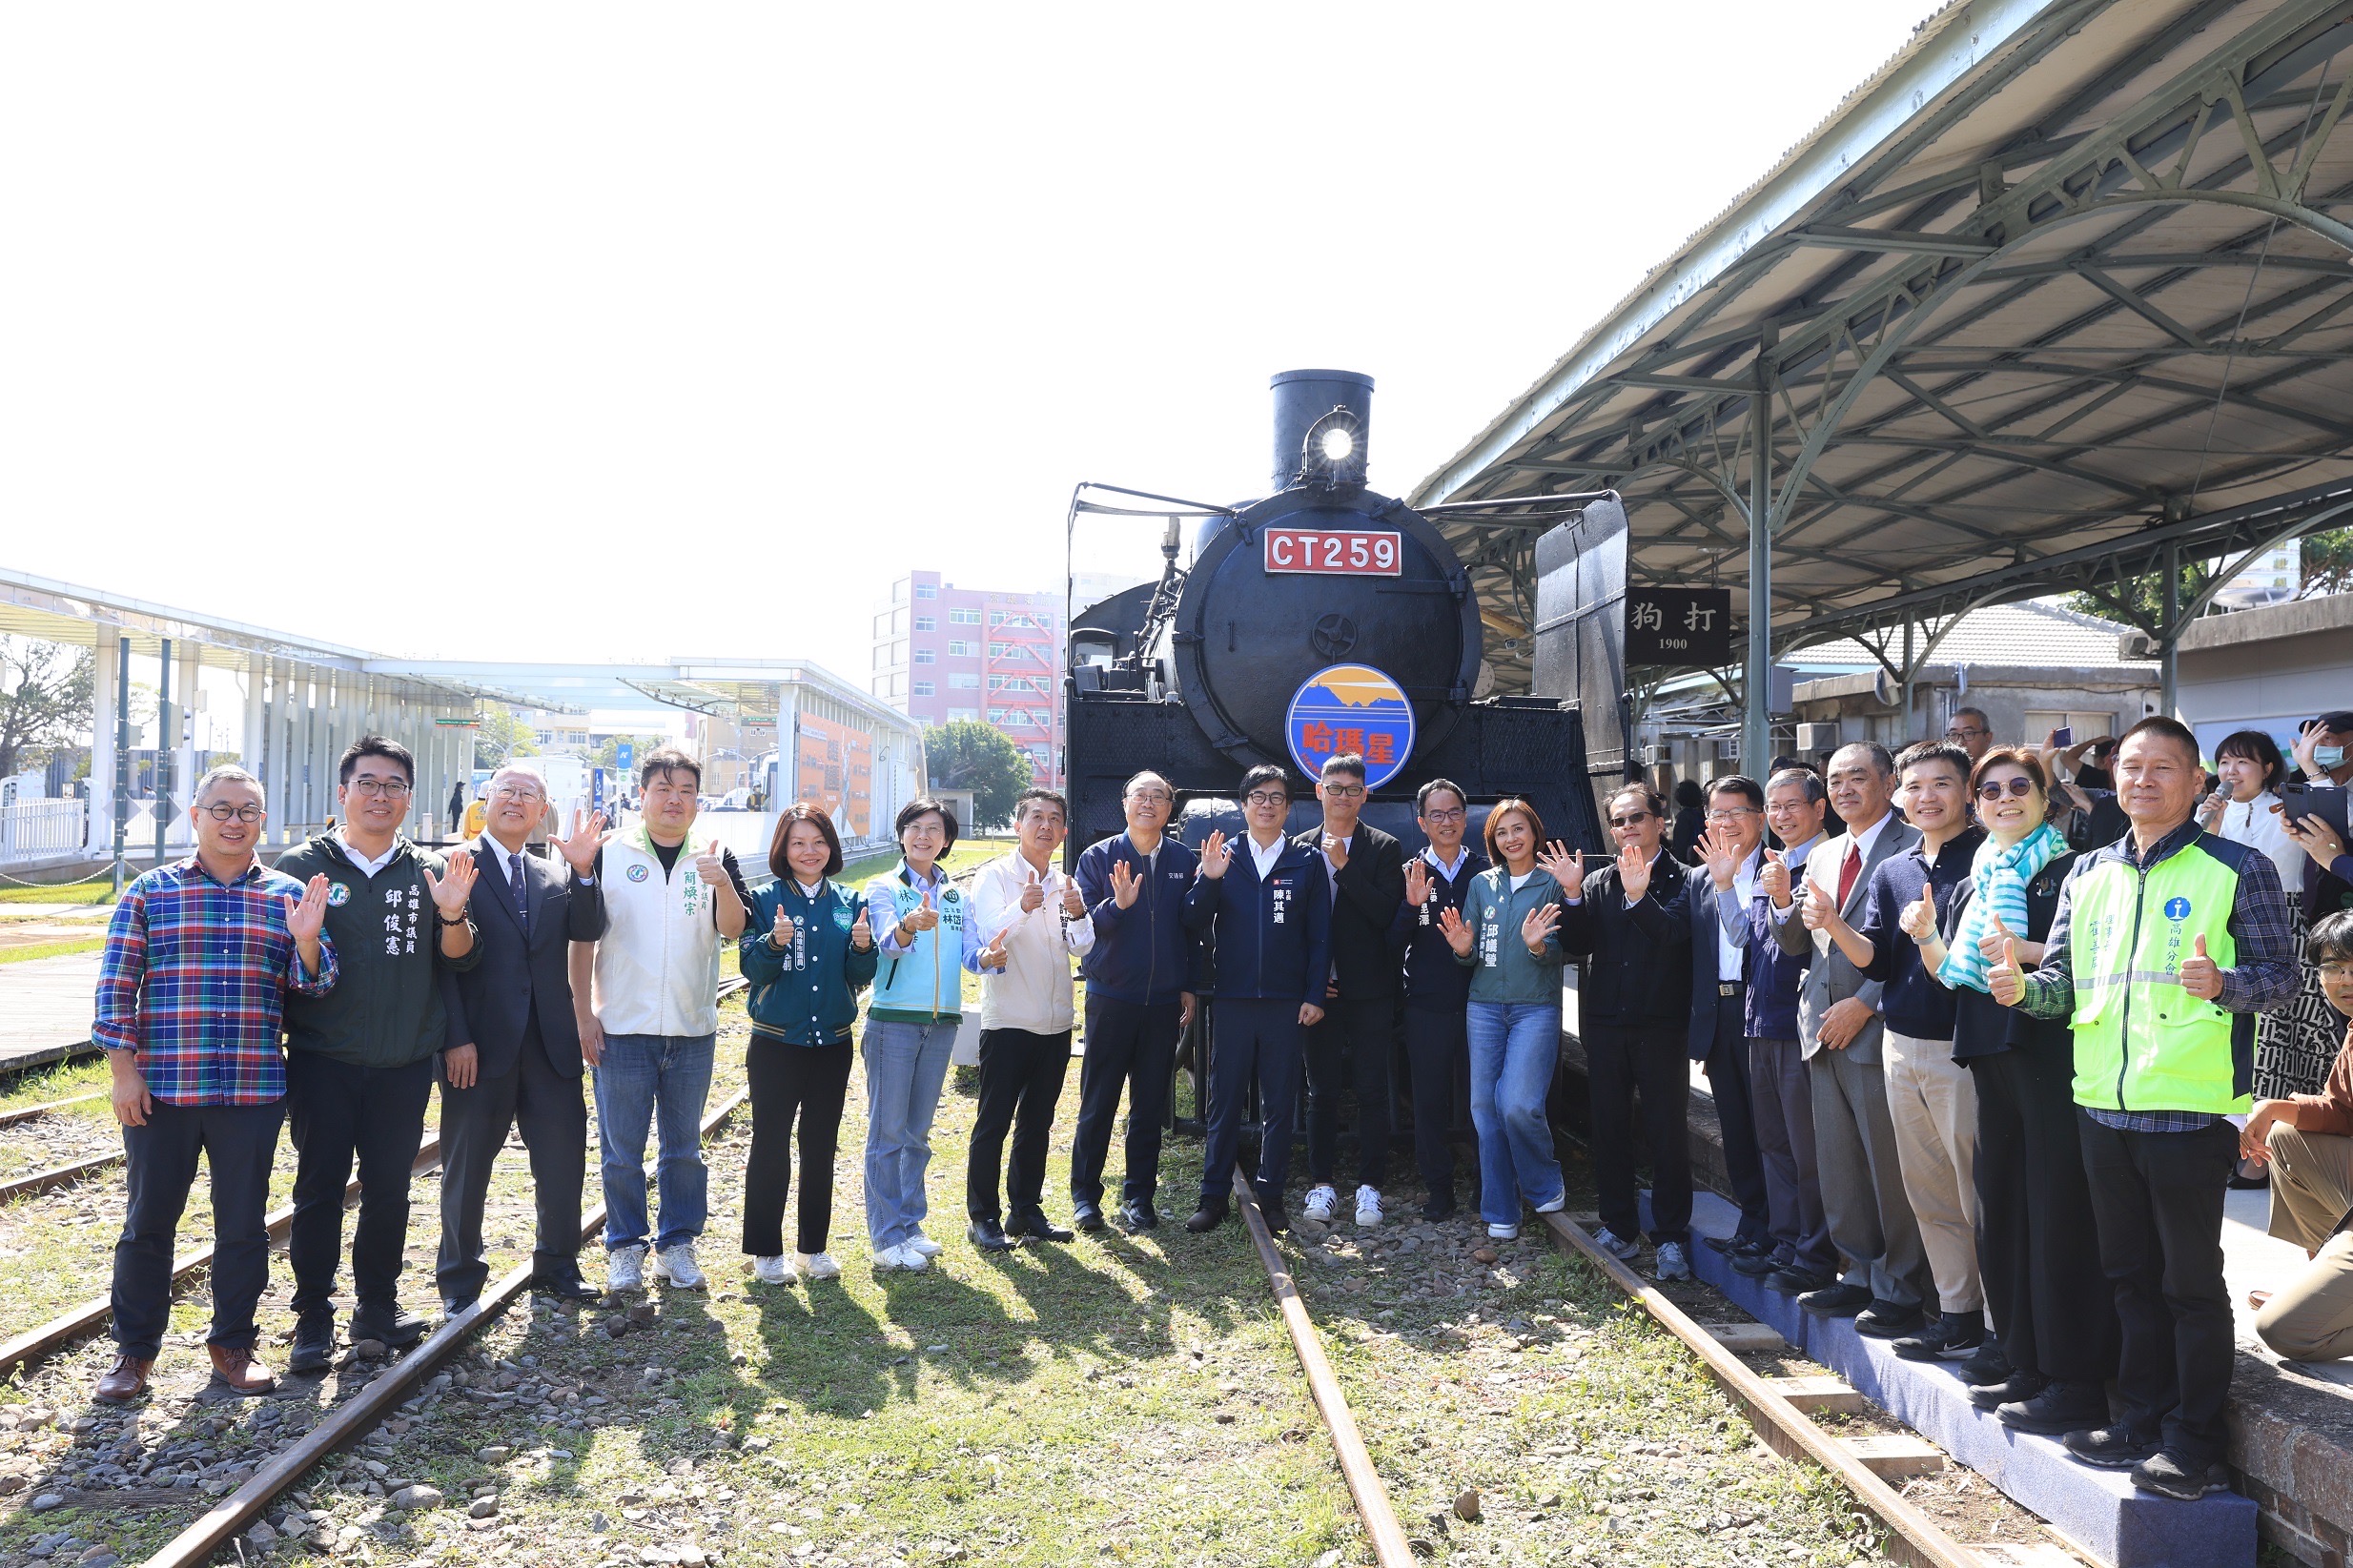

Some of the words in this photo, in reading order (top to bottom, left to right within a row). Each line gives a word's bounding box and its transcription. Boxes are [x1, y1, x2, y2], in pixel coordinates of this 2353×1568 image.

[1272, 535, 1395, 569] CT259
[1659, 638, 1688, 650] 1900
[1302, 720, 1396, 764] 哈瑪星
[683, 871, 698, 916] 簡煥宗
[1273, 889, 1285, 924] 陳其邁
[1285, 889, 1292, 901] 市長
[1429, 886, 1438, 903] 立委
[383, 888, 403, 956] 邱俊憲
[405, 884, 420, 954] 高雄市議員
[943, 913, 965, 926] 林岱
[1479, 923, 1487, 959] 立法委員
[1484, 924, 1499, 967] 邱議瑩
[2164, 923, 2181, 976] 高雄分會
